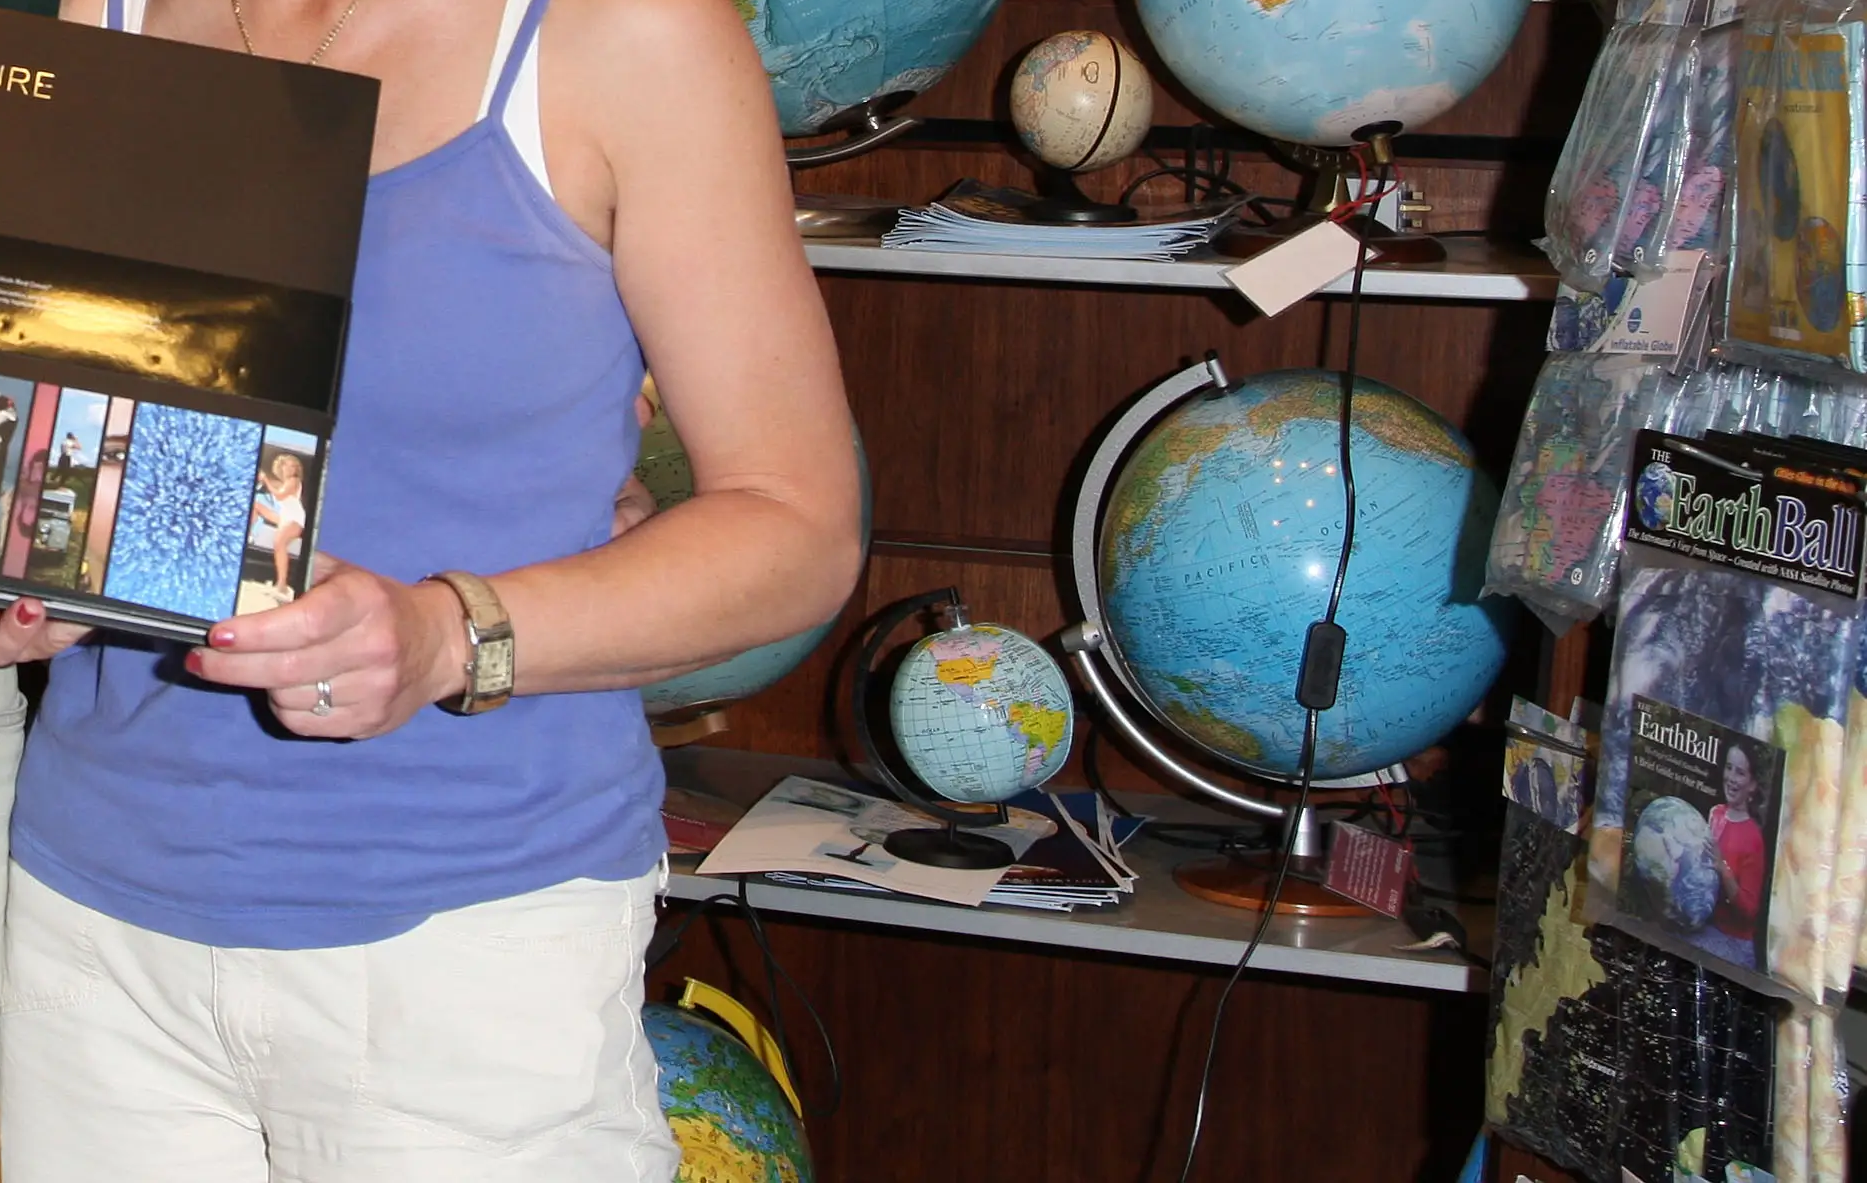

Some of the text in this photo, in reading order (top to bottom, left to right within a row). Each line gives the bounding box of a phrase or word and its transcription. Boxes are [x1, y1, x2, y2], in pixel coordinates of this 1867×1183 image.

[1611, 340, 1675, 352] Inflatable Globe
[1651, 448, 1672, 464] THE
[1320, 501, 1379, 537] OCAN
[1666, 471, 1859, 576] EarthBall
[1184, 554, 1259, 584] PACIFIC
[1639, 530, 1677, 548] Astronaut's
[1691, 543, 1708, 556] from
[1707, 548, 1727, 561] Space
[1734, 556, 1761, 572] Created
[1760, 561, 1779, 575] with
[1778, 566, 1799, 580] NASA
[1799, 571, 1830, 588] Satellite
[1637, 711, 1719, 765] EarthBall
